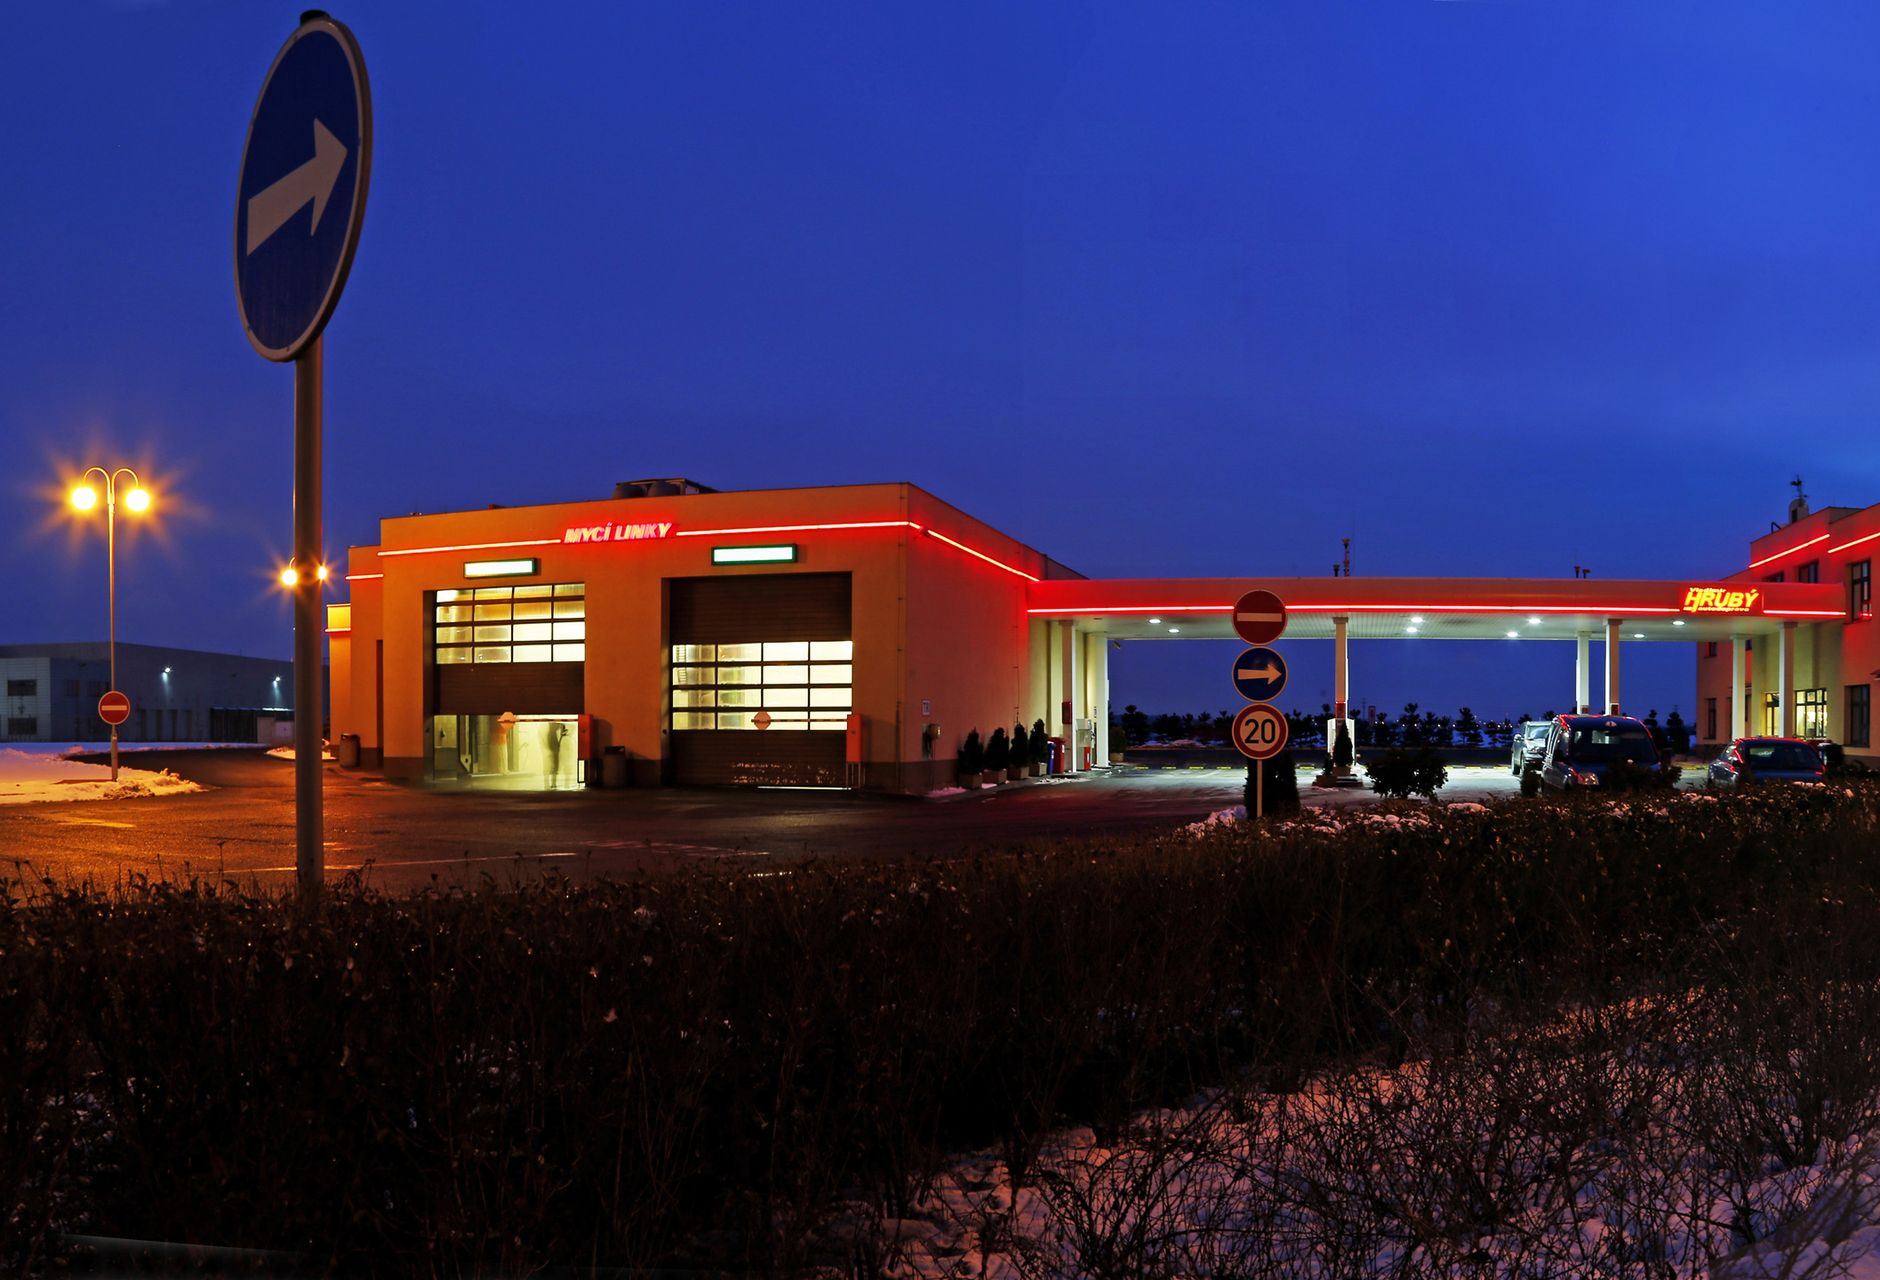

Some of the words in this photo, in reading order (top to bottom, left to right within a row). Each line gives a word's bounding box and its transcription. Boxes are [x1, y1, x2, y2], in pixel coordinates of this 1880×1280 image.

[564, 522, 613, 543] MYCÍ
[614, 522, 672, 540] LINKY
[1684, 589, 1760, 612] HRUBÝ
[1244, 718, 1276, 744] 20
